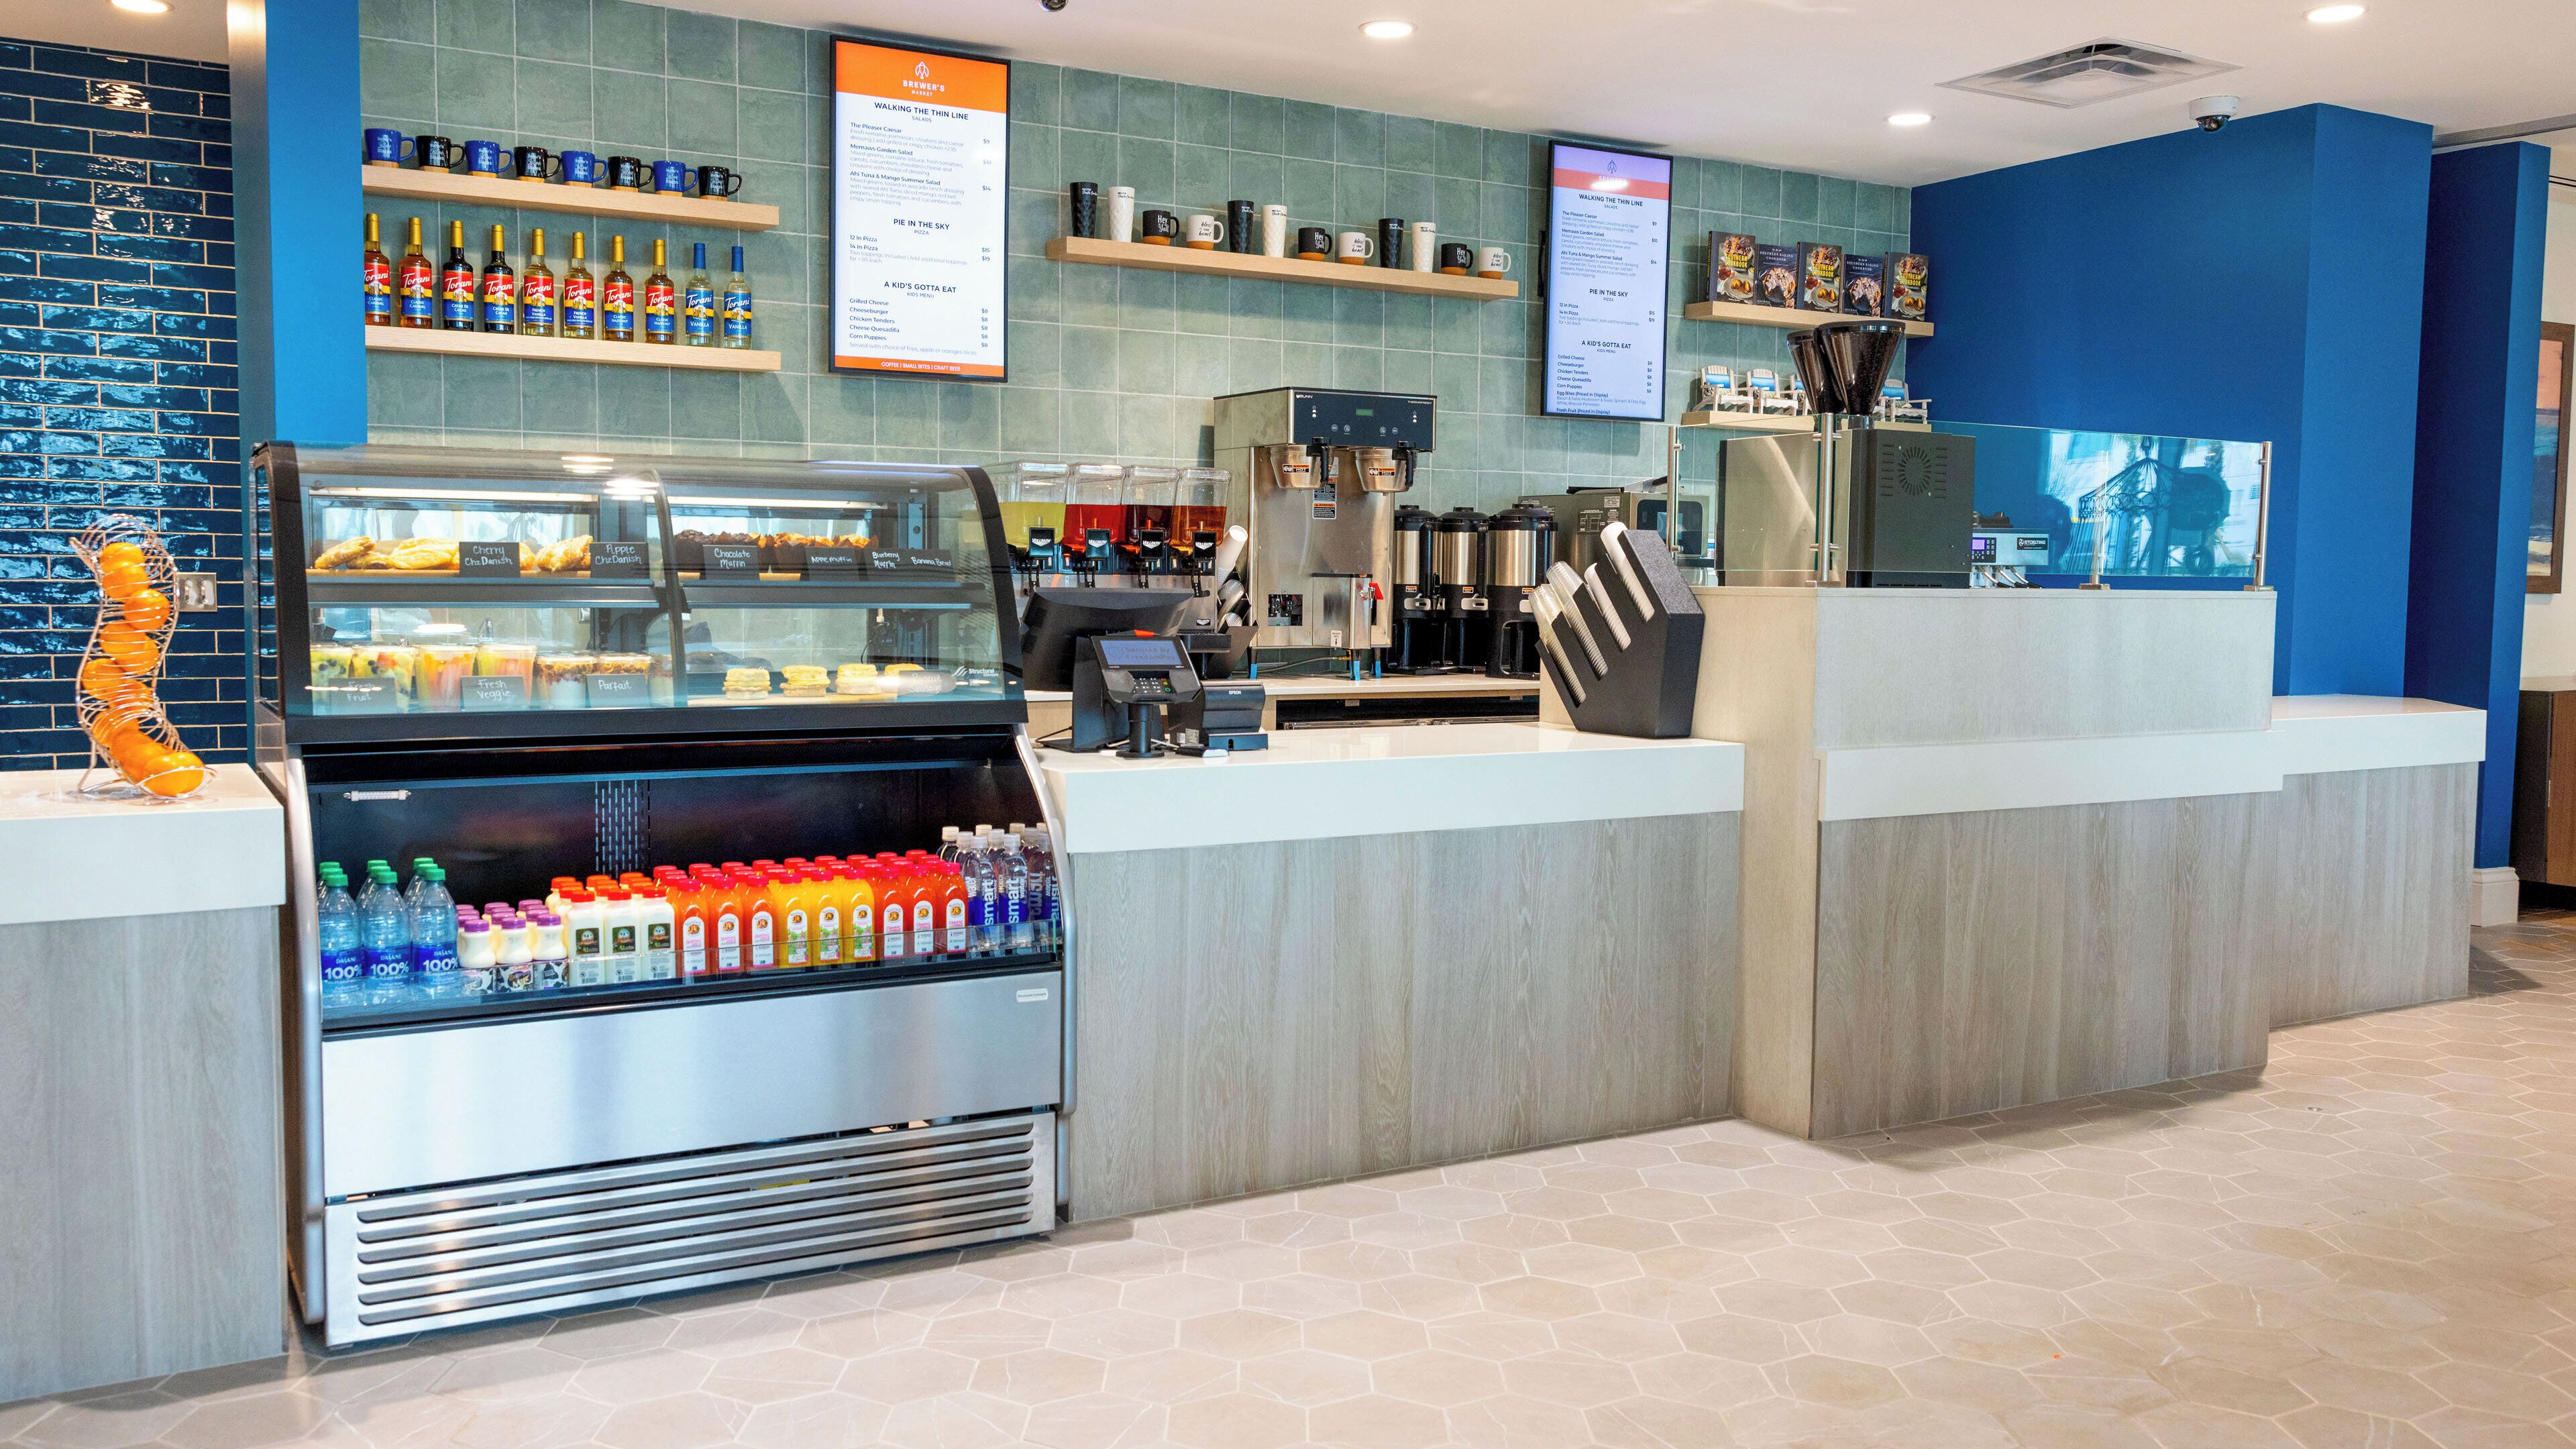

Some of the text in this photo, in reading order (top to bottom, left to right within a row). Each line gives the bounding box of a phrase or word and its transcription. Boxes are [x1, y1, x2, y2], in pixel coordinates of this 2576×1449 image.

[903, 80, 945, 91] BREWER'S
[875, 102, 911, 112] WALKING
[931, 109, 949, 117] THIN
[1579, 194, 1604, 202] WALKING
[1158, 215, 1168, 224] Hey
[1315, 232, 1324, 240] Hey
[1457, 248, 1466, 256] Hey
[364, 268, 389, 282] Torani
[402, 272, 431, 288] Torani
[445, 276, 472, 292] Torani
[486, 280, 513, 296] Torani
[525, 281, 552, 297] Torani
[566, 285, 592, 300] Torani
[606, 288, 632, 303] Torani
[648, 292, 674, 307] Torani
[687, 294, 712, 309] Torani
[725, 297, 750, 311] Torani
[473, 545, 505, 557] Cherry
[606, 543, 635, 555] Apple
[714, 549, 751, 558] Chocolate
[871, 551, 900, 561] Blueberry
[910, 557, 934, 566] Banana
[720, 558, 746, 569] Muffin
[873, 559, 896, 569] Muffin
[478, 679, 506, 689] Fresh
[598, 680, 631, 691] Parfait
[347, 692, 372, 702] Fruit
[476, 690, 511, 700] Veggie
[982, 878, 994, 926] smart
[1008, 877, 1020, 924] smart
[370, 961, 409, 976] 100%
[423, 958, 459, 972] 100%
[325, 965, 362, 979] 100%
